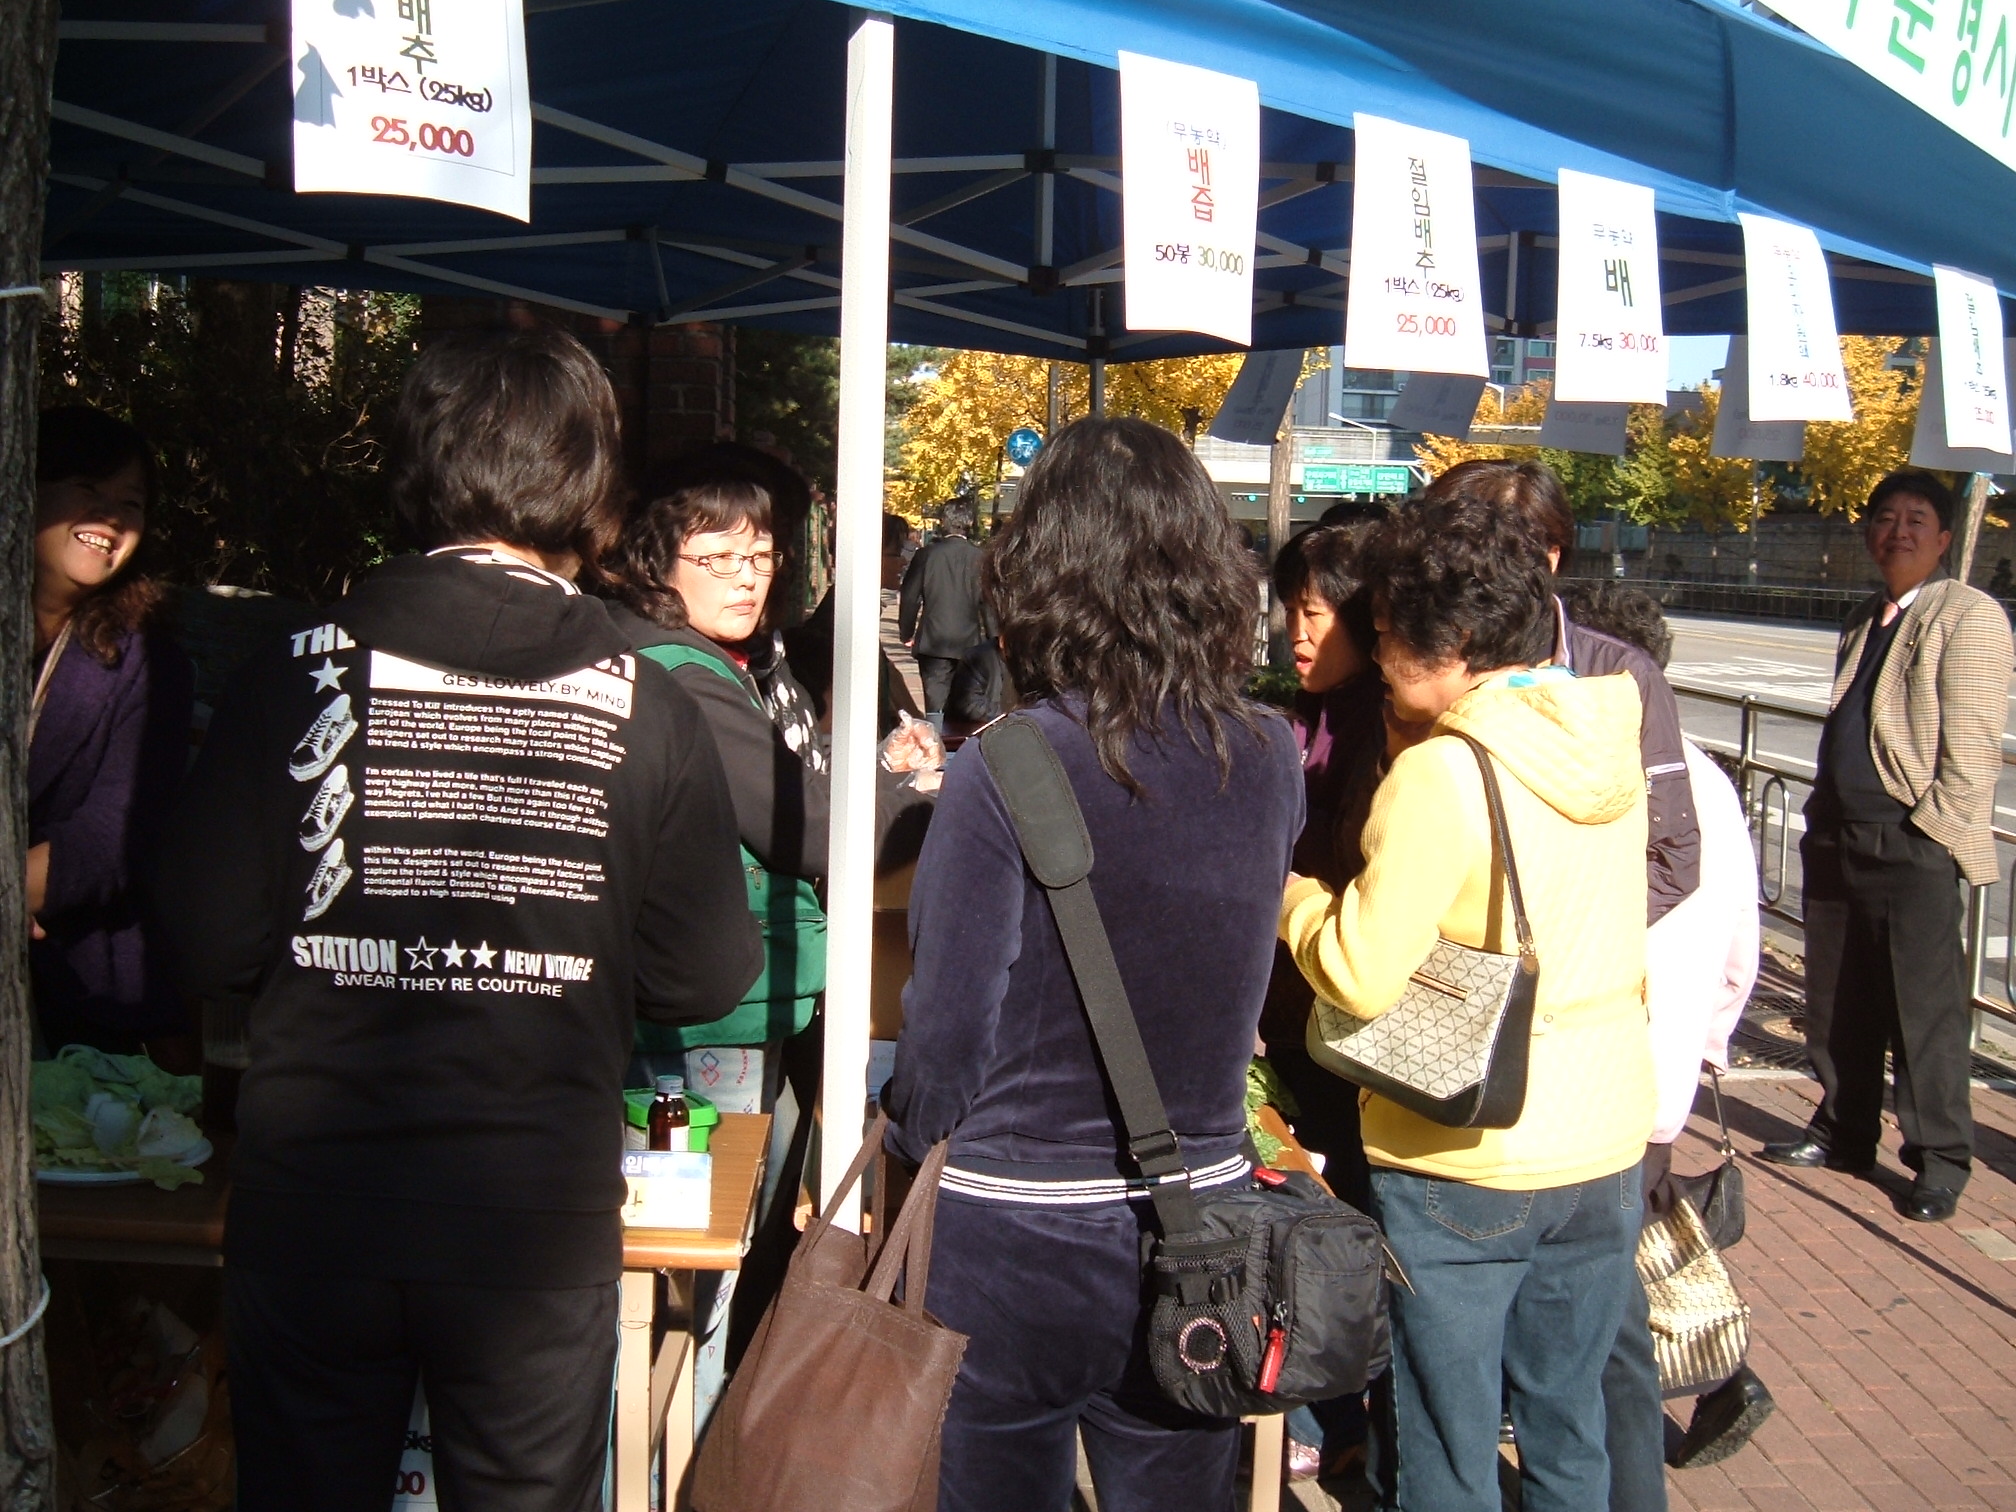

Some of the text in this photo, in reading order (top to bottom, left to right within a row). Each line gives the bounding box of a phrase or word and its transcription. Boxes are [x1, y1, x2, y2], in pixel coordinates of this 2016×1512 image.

[346, 65, 493, 113] 1박스 (25kg)
[371, 115, 475, 158] 25,000
[1187, 148, 1214, 222] 배즙
[1408, 156, 1436, 279] 절임배추
[1155, 243, 1244, 276] 50봉 30,000
[1384, 276, 1465, 303] 1박스 (25kg)
[1604, 258, 1633, 308] 배
[1397, 313, 1456, 338] 25,000
[1579, 333, 1613, 351] 7.5kg
[1769, 372, 1799, 389] 1.8kg
[412, 700, 569, 719] To introduces the aptly named
[586, 688, 626, 709] MIND
[368, 719, 387, 727] part
[389, 719, 399, 727] of
[401, 719, 417, 728] the
[449, 722, 482, 733] Europe
[483, 725, 510, 736] being
[511, 727, 527, 736] the
[528, 728, 551, 737] focal
[552, 731, 577, 741] point
[413, 711, 442, 720] which
[443, 713, 478, 722] evolves
[480, 715, 502, 724] from
[504, 717, 530, 728] many
[531, 719, 561, 729] places
[367, 728, 413, 738] designers
[415, 731, 430, 739] set
[448, 733, 459, 741] to
[460, 735, 501, 744] research
[502, 738, 528, 748] many
[367, 738, 383, 747] the
[384, 739, 409, 748] trend
[419, 741, 442, 751] style
[443, 743, 471, 752] which
[472, 745, 525, 756] encompass
[534, 751, 565, 761] strong
[365, 778, 592, 804] every highway And much more than this did
[380, 768, 414, 777] certain
[432, 770, 455, 779] lived
[507, 775, 522, 784] full
[529, 778, 566, 789] traveled
[566, 783, 589, 793] each
[364, 789, 384, 797] way
[441, 790, 460, 799] had
[468, 792, 485, 800] few
[486, 793, 503, 803] But
[504, 796, 525, 805] then
[526, 798, 551, 808] again
[552, 801, 567, 810] too
[568, 803, 584, 812] few
[585, 806, 595, 815] to
[411, 799, 427, 808] did
[428, 801, 450, 809] what
[456, 801, 474, 810] had
[475, 802, 485, 811] to
[486, 803, 499, 812] do
[500, 805, 518, 815] And
[519, 808, 538, 816] saw
[547, 811, 581, 823] through
[418, 811, 455, 820] planned
[456, 812, 478, 820] each
[479, 814, 523, 825] chartered
[523, 818, 554, 829] course
[555, 822, 576, 832] Each
[363, 857, 380, 865] this
[403, 858, 448, 868] designers
[449, 859, 464, 867] set
[464, 860, 480, 868] out
[480, 861, 490, 870] to
[491, 863, 531, 874] research
[531, 867, 556, 878] many
[393, 847, 411, 855] this
[412, 848, 431, 856] part
[432, 848, 443, 856] of
[444, 848, 458, 857] the
[488, 851, 521, 862] Europe
[521, 855, 547, 866] being
[548, 858, 563, 867] the
[563, 859, 584, 870] focal
[363, 867, 584, 892] capture the trend style which encompass strong
[363, 877, 413, 886] continental
[449, 879, 485, 889] Dressed
[487, 882, 497, 890] To
[520, 885, 565, 898] Alternative
[363, 887, 516, 905] developed to high standard using
[291, 935, 398, 975] STATION
[504, 949, 542, 977] NEW
[334, 972, 563, 998] SWEAR THEY RE COUTURE
